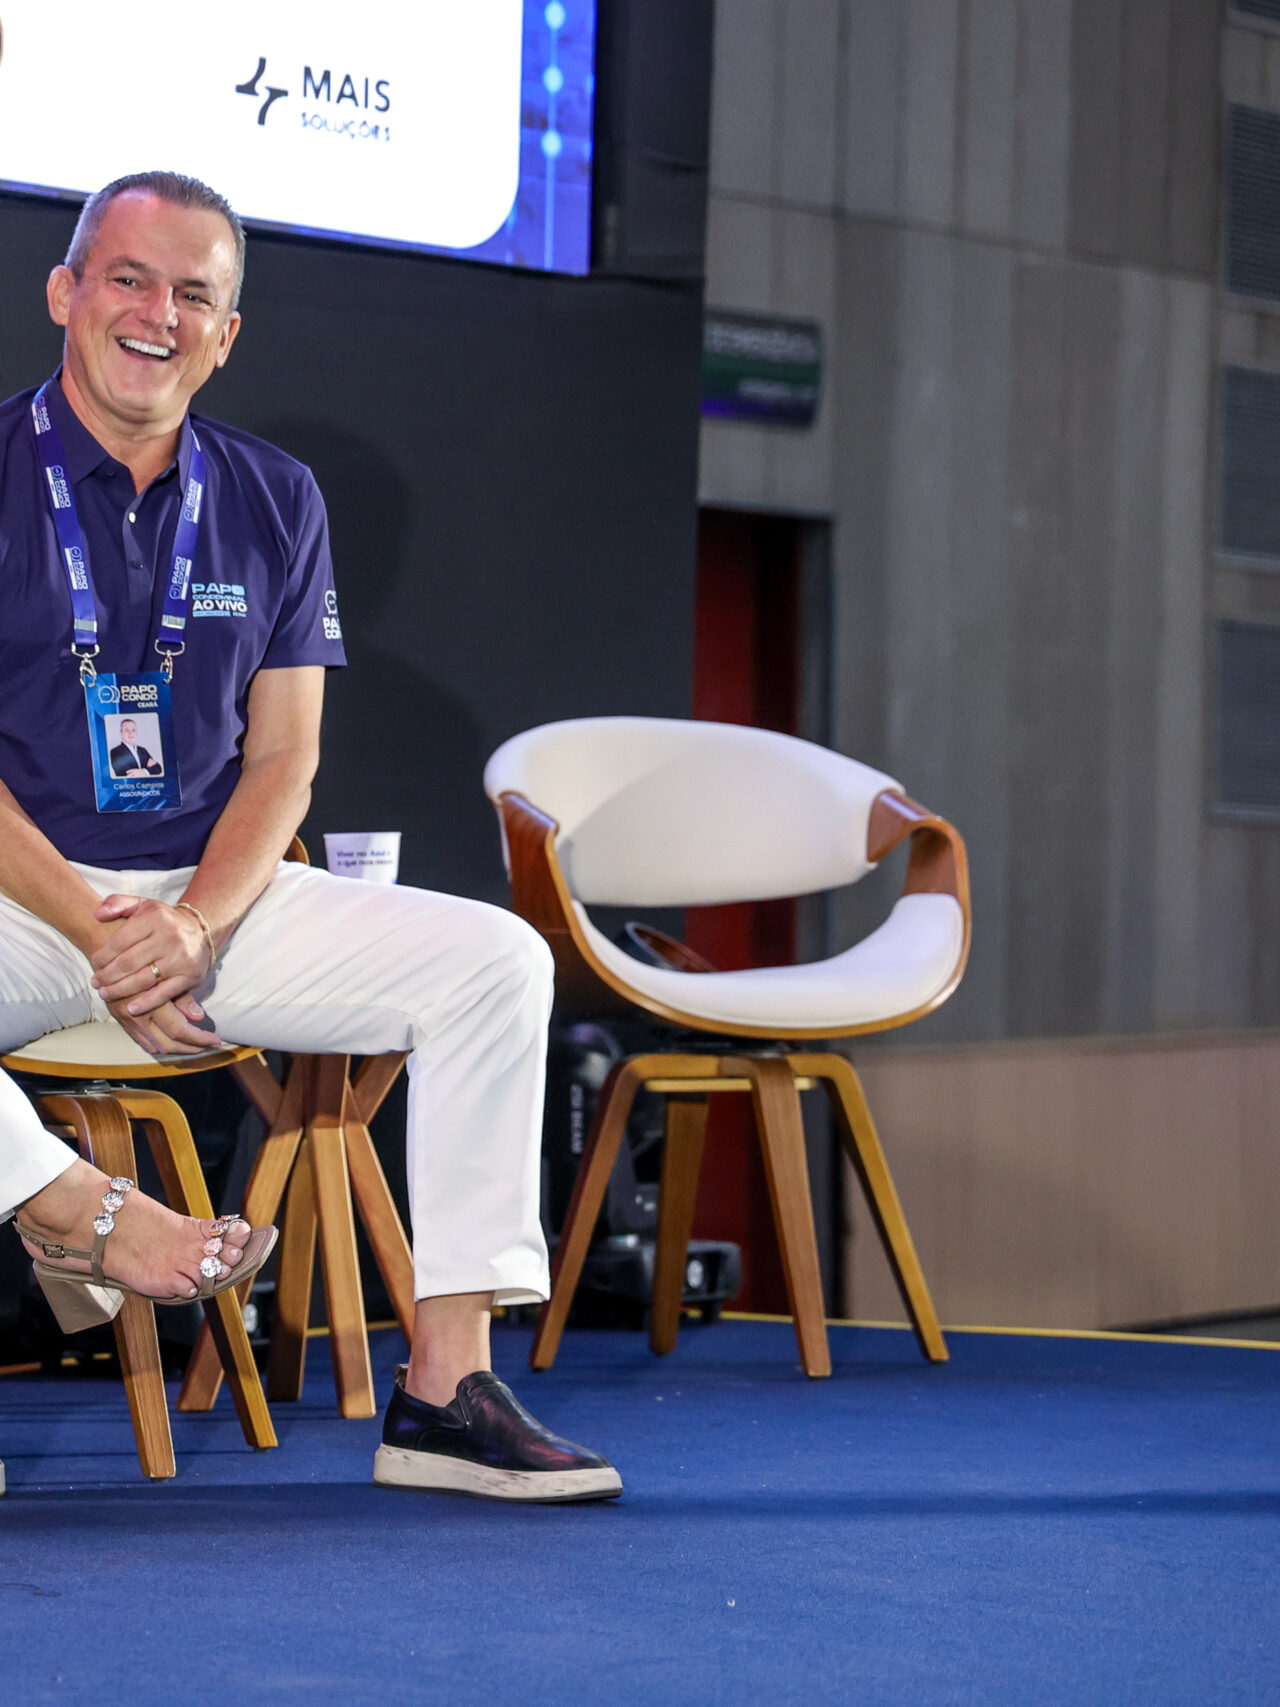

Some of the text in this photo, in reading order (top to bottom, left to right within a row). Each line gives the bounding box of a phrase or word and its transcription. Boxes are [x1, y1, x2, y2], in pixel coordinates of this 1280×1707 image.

[304, 66, 390, 112] MAIS
[59, 479, 71, 508] PAPO
[77, 561, 88, 590] PAPO
[172, 556, 182, 584] PAPO
[191, 582, 245, 595] PAPO
[192, 600, 247, 612] AO VIVO
[120, 685, 157, 694] PAPO
[121, 693, 158, 702] CONDO
[136, 782, 164, 790] Campos
